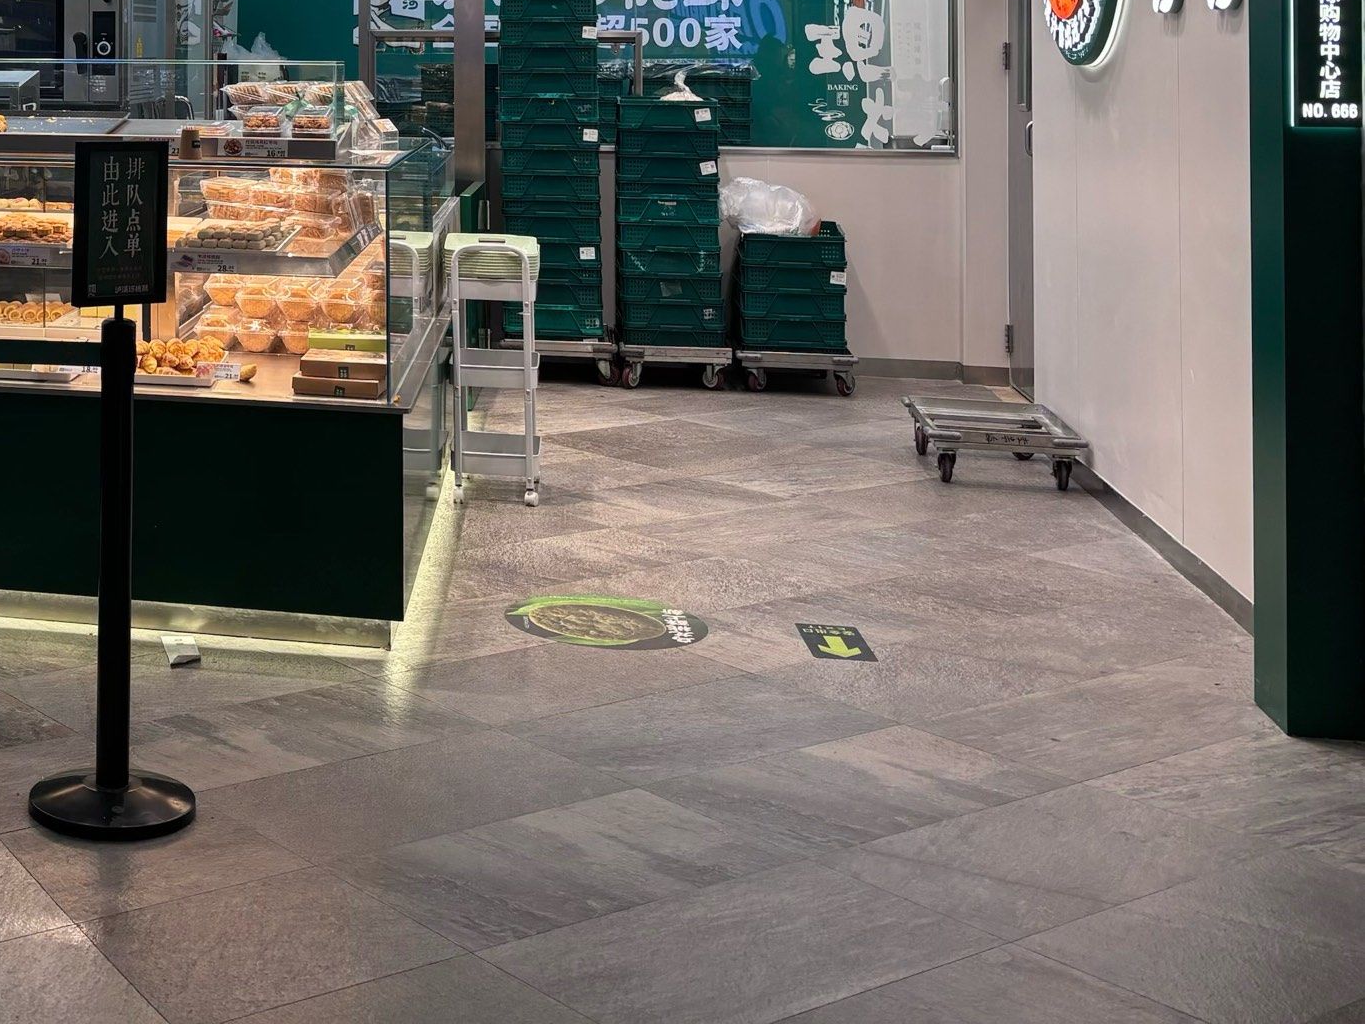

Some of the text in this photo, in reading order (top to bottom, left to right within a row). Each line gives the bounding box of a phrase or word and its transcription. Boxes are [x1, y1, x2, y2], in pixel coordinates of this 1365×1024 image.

[827, 83, 859, 91] BAKING
[1302, 102, 1358, 118] NO. 666
[99, 156, 120, 260] 由此进入
[123, 157, 145, 258] 排队点单
